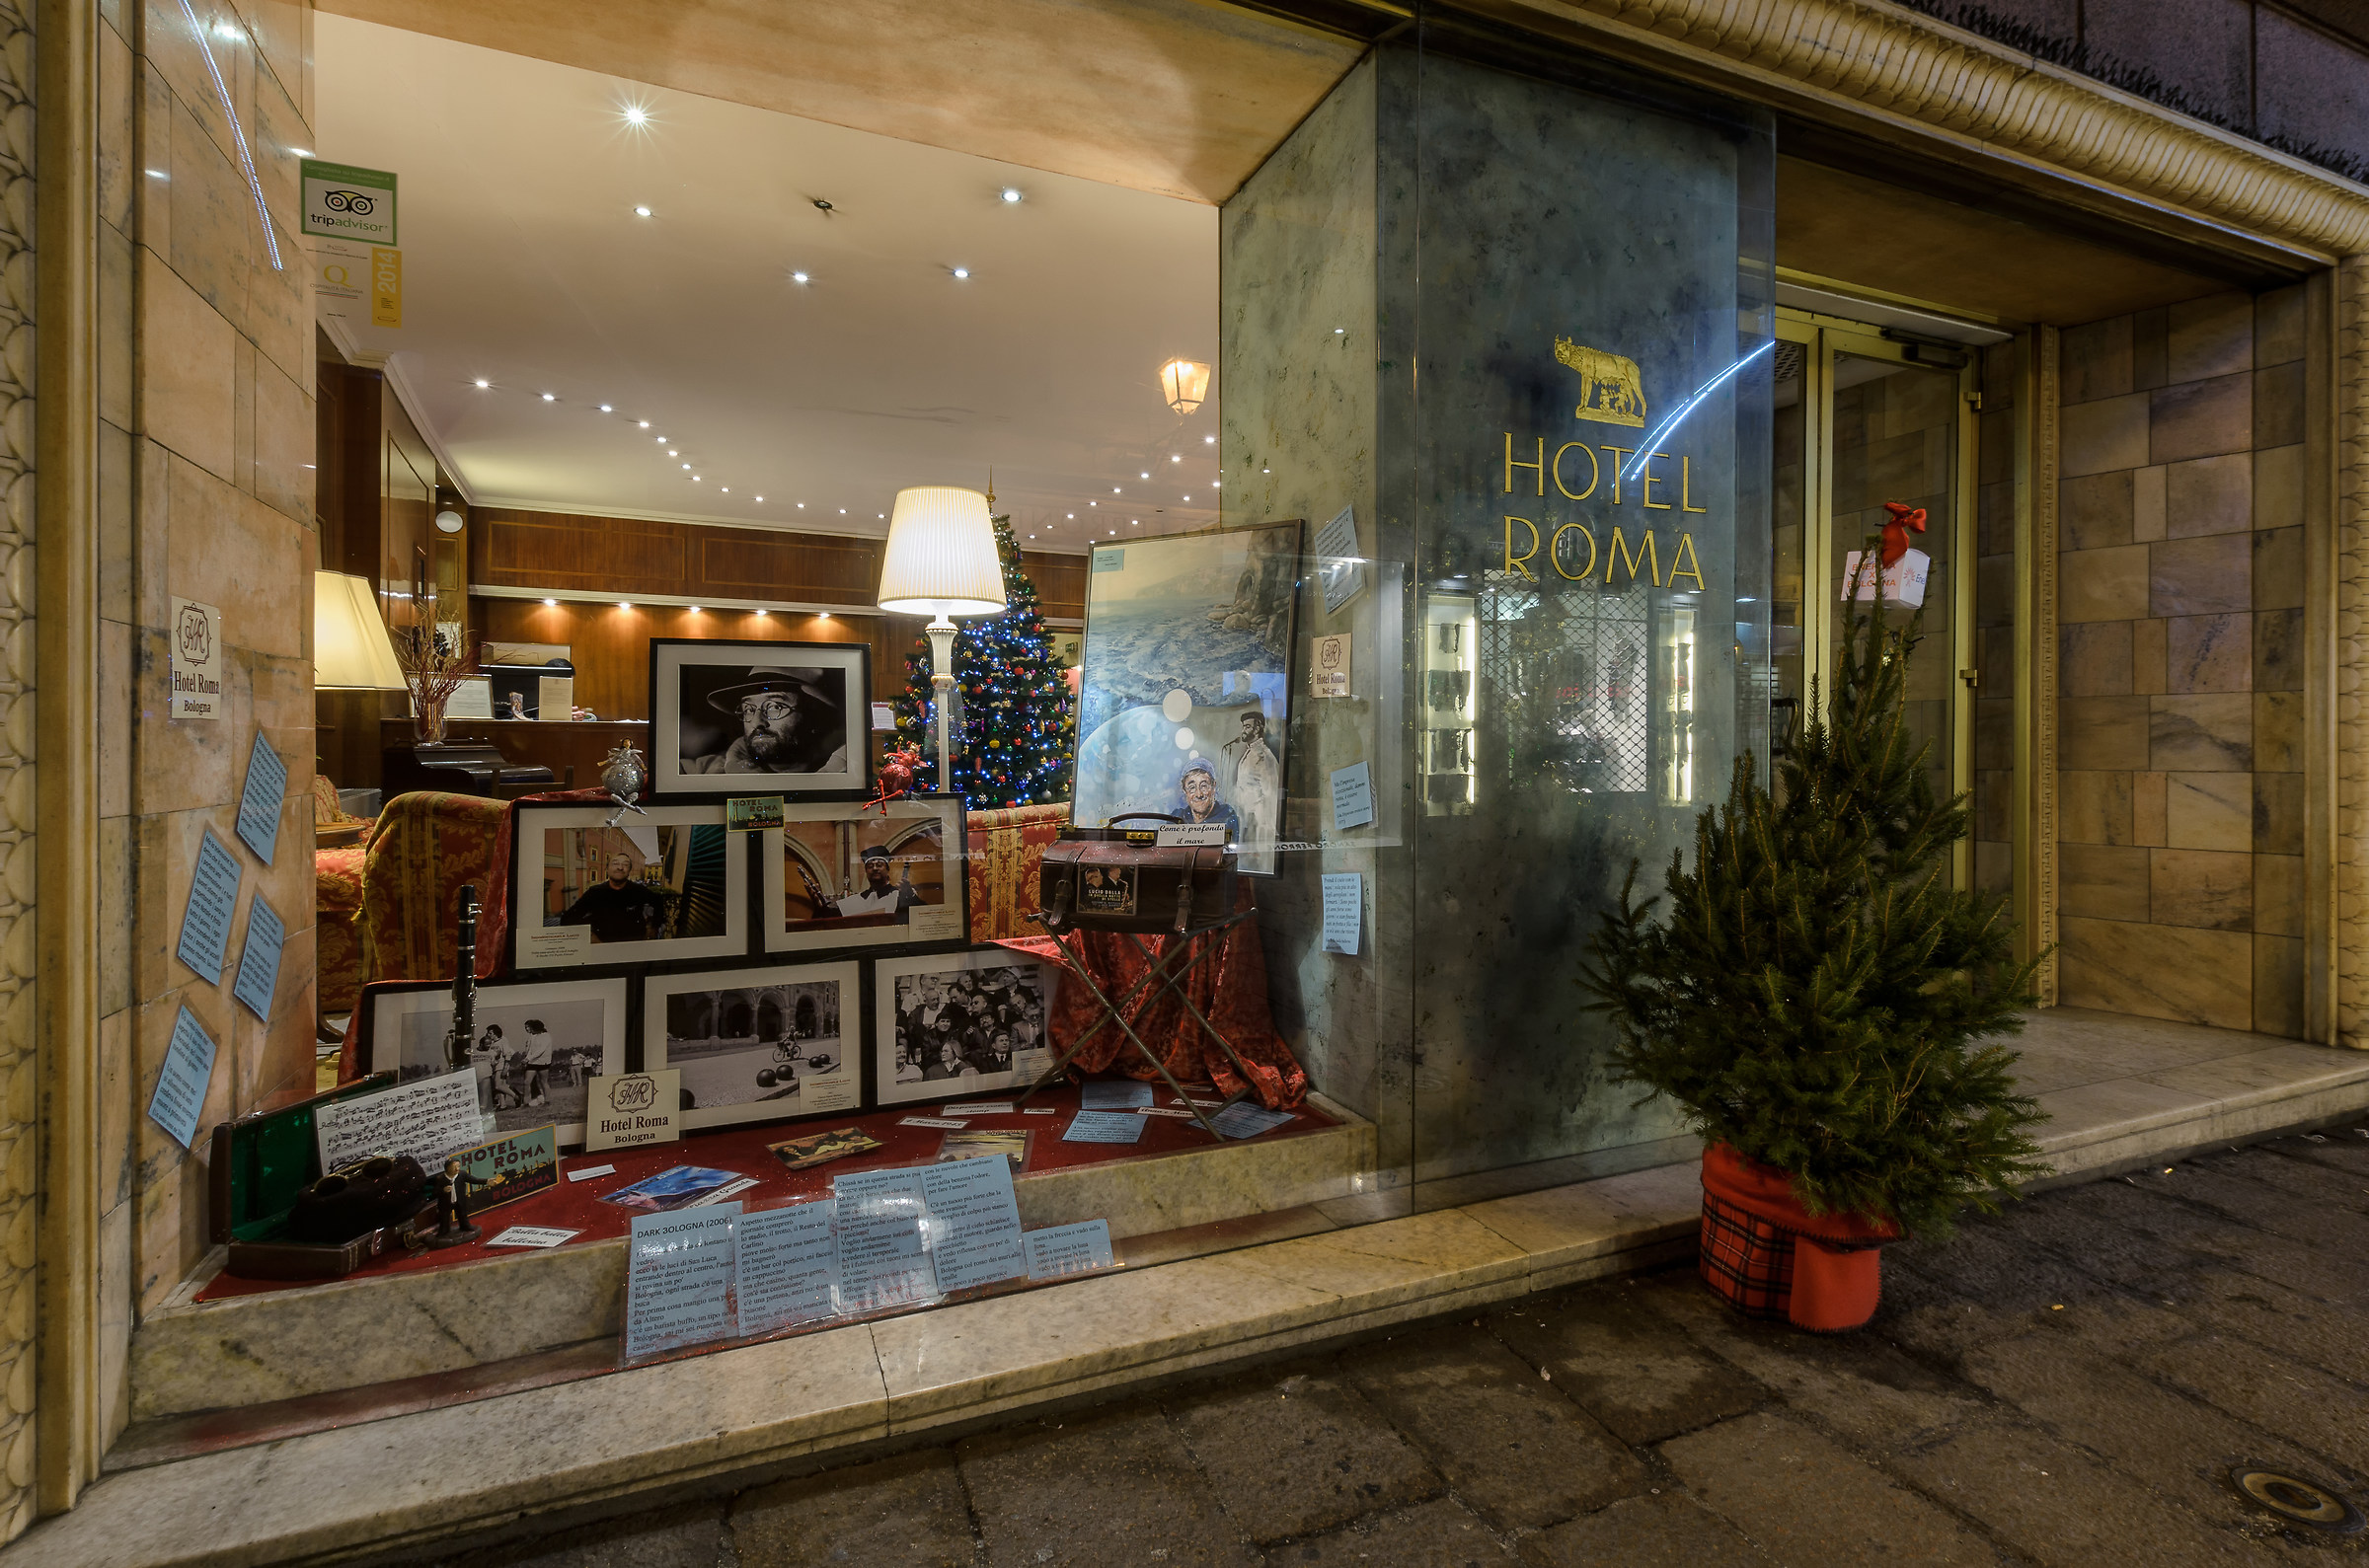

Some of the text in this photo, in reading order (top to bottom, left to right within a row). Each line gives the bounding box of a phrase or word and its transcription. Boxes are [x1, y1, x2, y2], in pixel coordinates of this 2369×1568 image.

[311, 214, 384, 232] tripadvisor
[324, 264, 354, 287] Q
[377, 252, 397, 294] 2014
[1503, 431, 1707, 513] HOTEL
[1503, 514, 1706, 591] ROMA
[174, 671, 219, 694] Hotel Roma
[1317, 673, 1345, 684] Hotel Roma
[184, 700, 211, 715] Bologna
[1187, 824, 1225, 833] profondo
[600, 1116, 668, 1134] Hotel Roma
[615, 1132, 655, 1144] Bologna
[461, 1140, 516, 1166] HOTEL
[494, 1144, 545, 1168] ROMA
[968, 1157, 993, 1166] cambiano
[494, 1173, 552, 1200] BOLOGNA
[637, 1228, 659, 1238] DARK
[706, 1216, 731, 1227] (2006)
[740, 1218, 762, 1228] Aspetto
[764, 1211, 796, 1222] mezzanotte
[740, 1219, 793, 1235] giornale comprerò
[740, 1240, 763, 1249] Carlino
[741, 1250, 758, 1259] piove
[751, 1253, 775, 1265] bagnerò
[783, 1255, 804, 1266] portico,
[635, 1288, 663, 1302] Bologna,
[664, 1286, 679, 1296] ogni
[680, 1281, 700, 1291] strada
